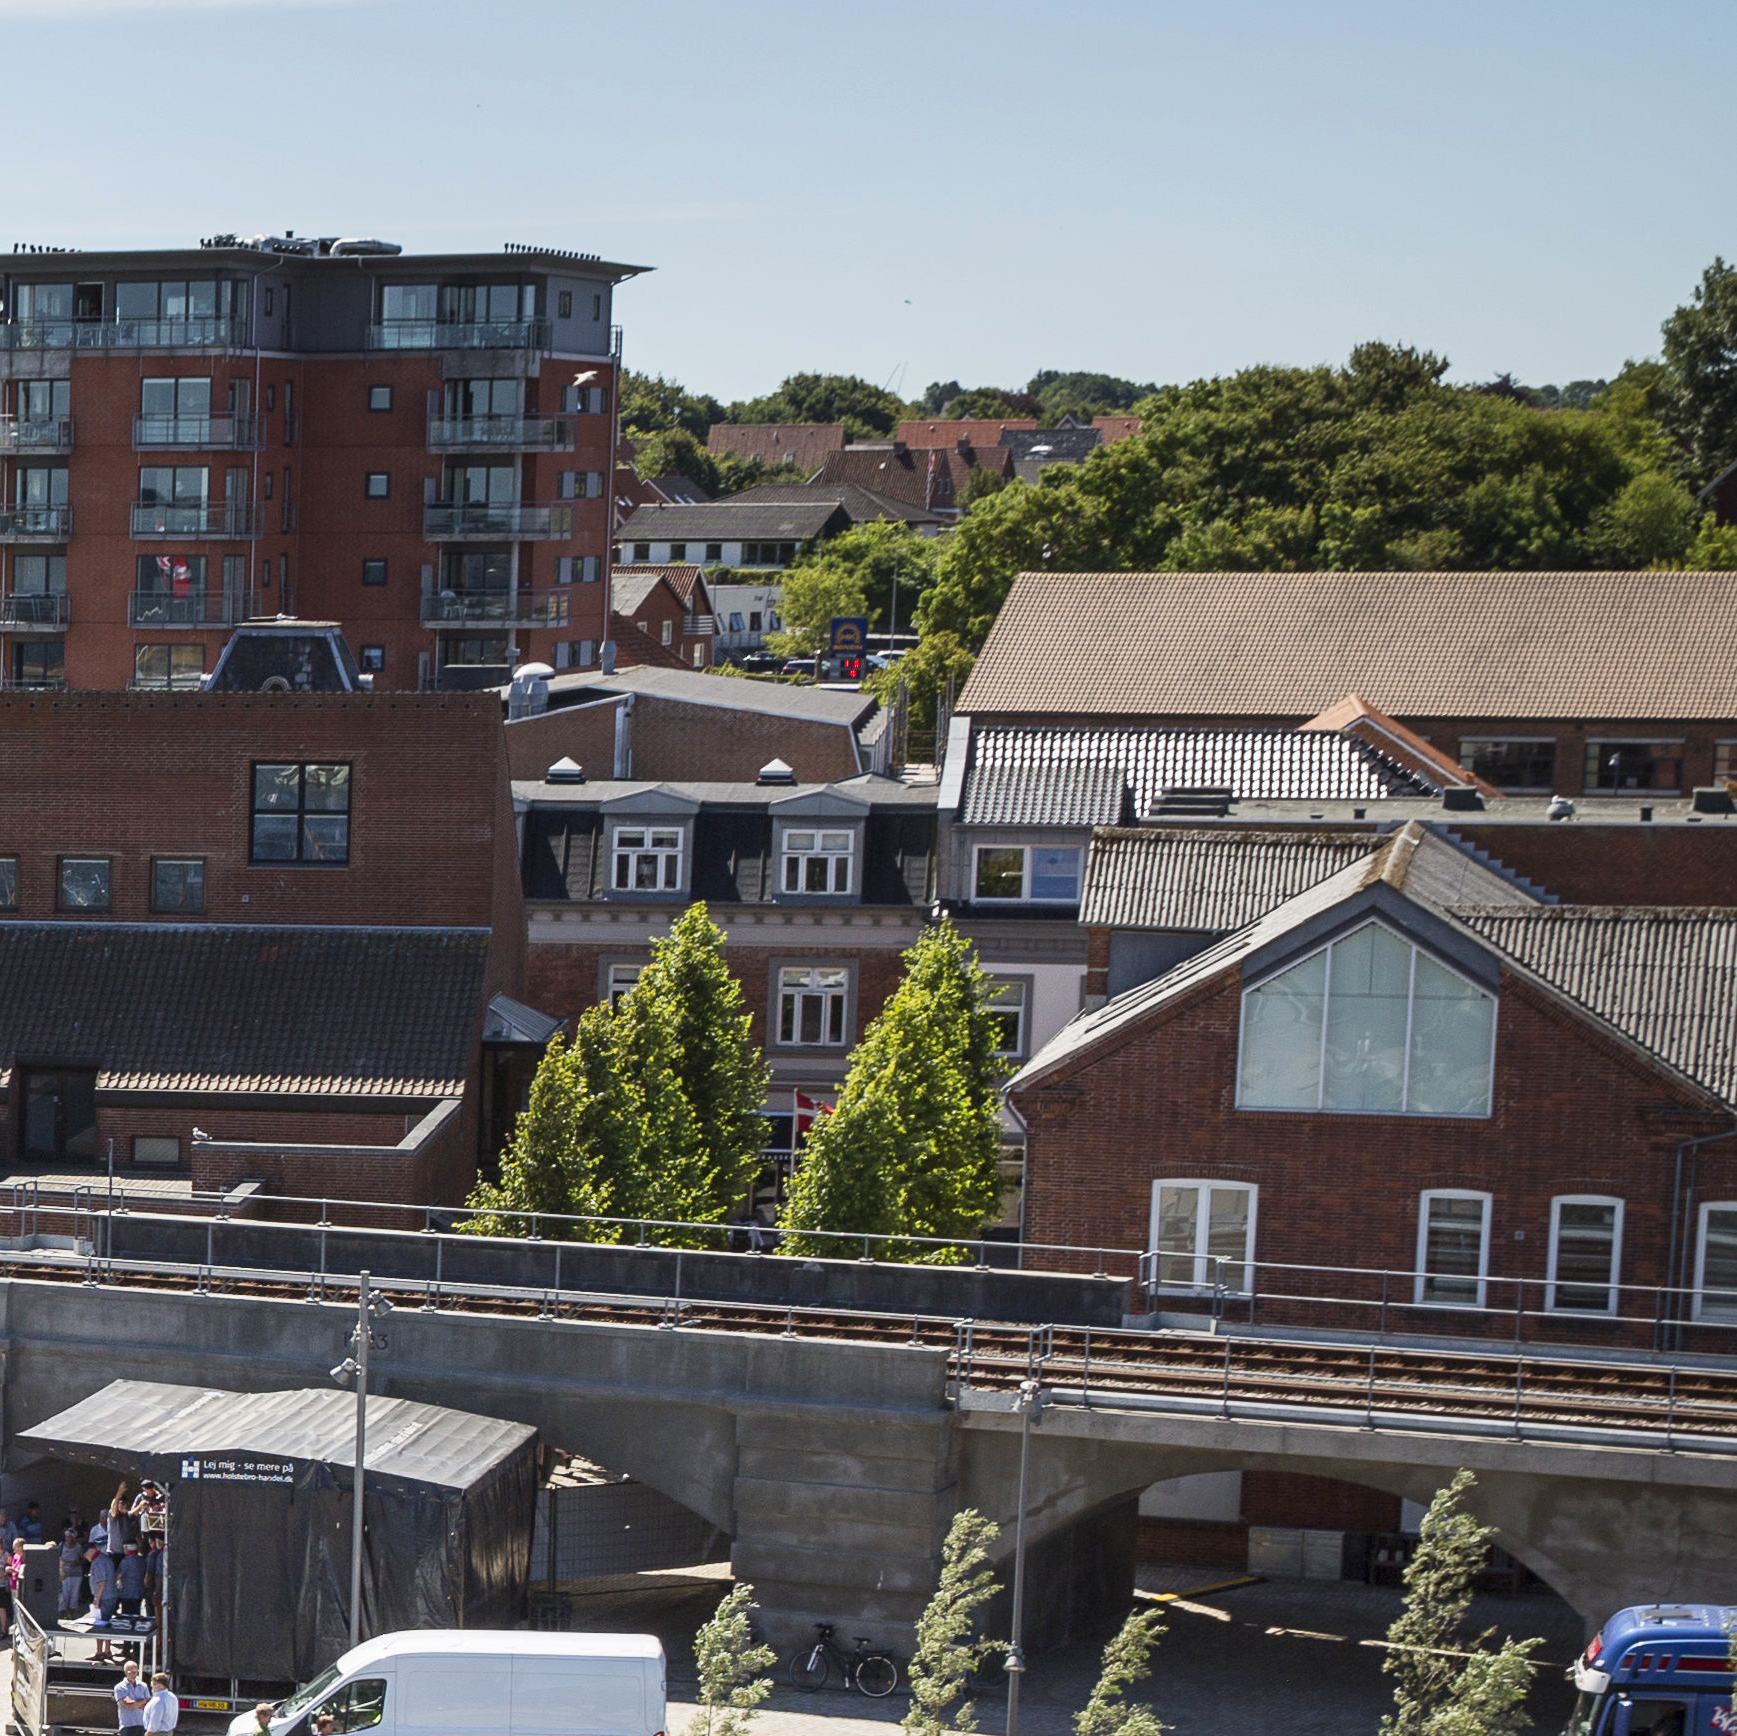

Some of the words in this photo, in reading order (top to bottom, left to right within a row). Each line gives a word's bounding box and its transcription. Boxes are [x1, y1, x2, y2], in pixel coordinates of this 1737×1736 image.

[203, 1460, 216, 1470] Lej
[219, 1460, 235, 1471] mig
[257, 1464, 280, 1472] mere
[282, 1463, 294, 1473] på
